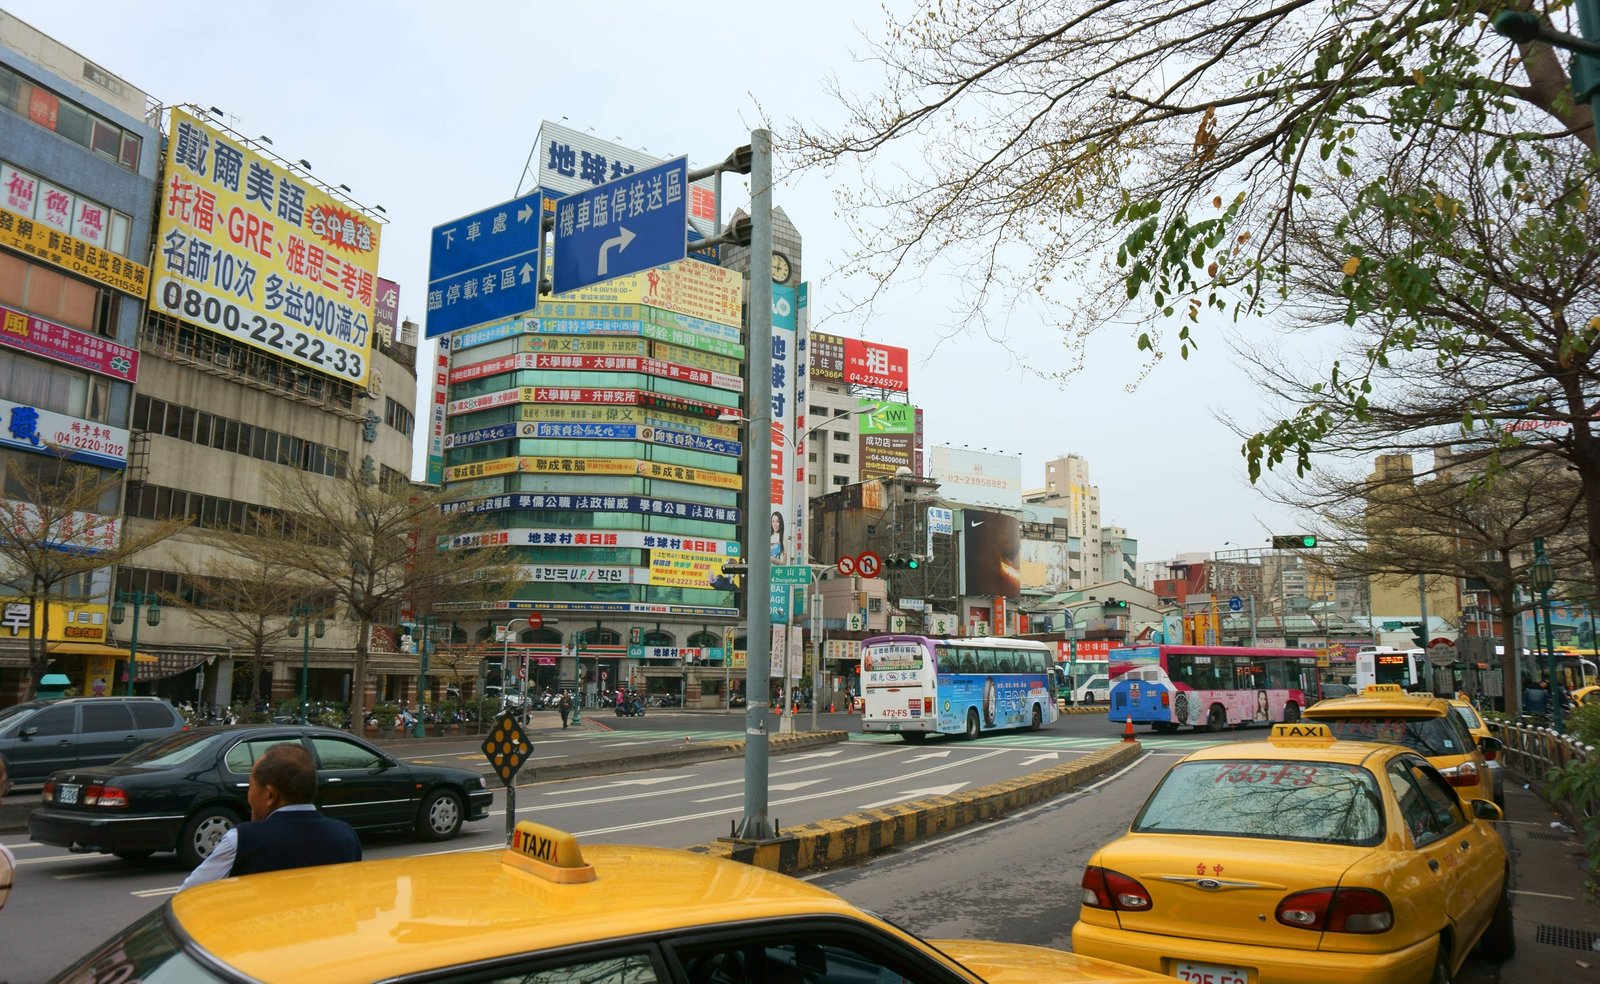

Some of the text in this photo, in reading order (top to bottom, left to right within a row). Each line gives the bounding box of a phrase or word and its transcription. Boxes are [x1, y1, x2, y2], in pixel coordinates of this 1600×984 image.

[175, 121, 306, 228] 戴爾美語
[559, 167, 682, 240] 機車臨停接送區
[309, 208, 373, 252] 台中最強
[442, 211, 508, 250] 下車處
[163, 228, 370, 348] 名師10次 多益990滿分
[428, 264, 517, 312] 臨停載客區
[163, 281, 362, 378] 0800-22-22-33
[866, 347, 889, 375] 租
[849, 372, 904, 388] 04-22245577
[536, 458, 586, 472] 聯成電腦
[652, 463, 695, 481] 聯成電腦
[528, 532, 618, 545] 地球村美日語
[643, 535, 717, 553] 地球村美日語
[775, 567, 807, 576] 中山路
[1276, 726, 1324, 737] TAXI
[522, 831, 551, 860] TAXI
[1196, 862, 1224, 876] 台中
